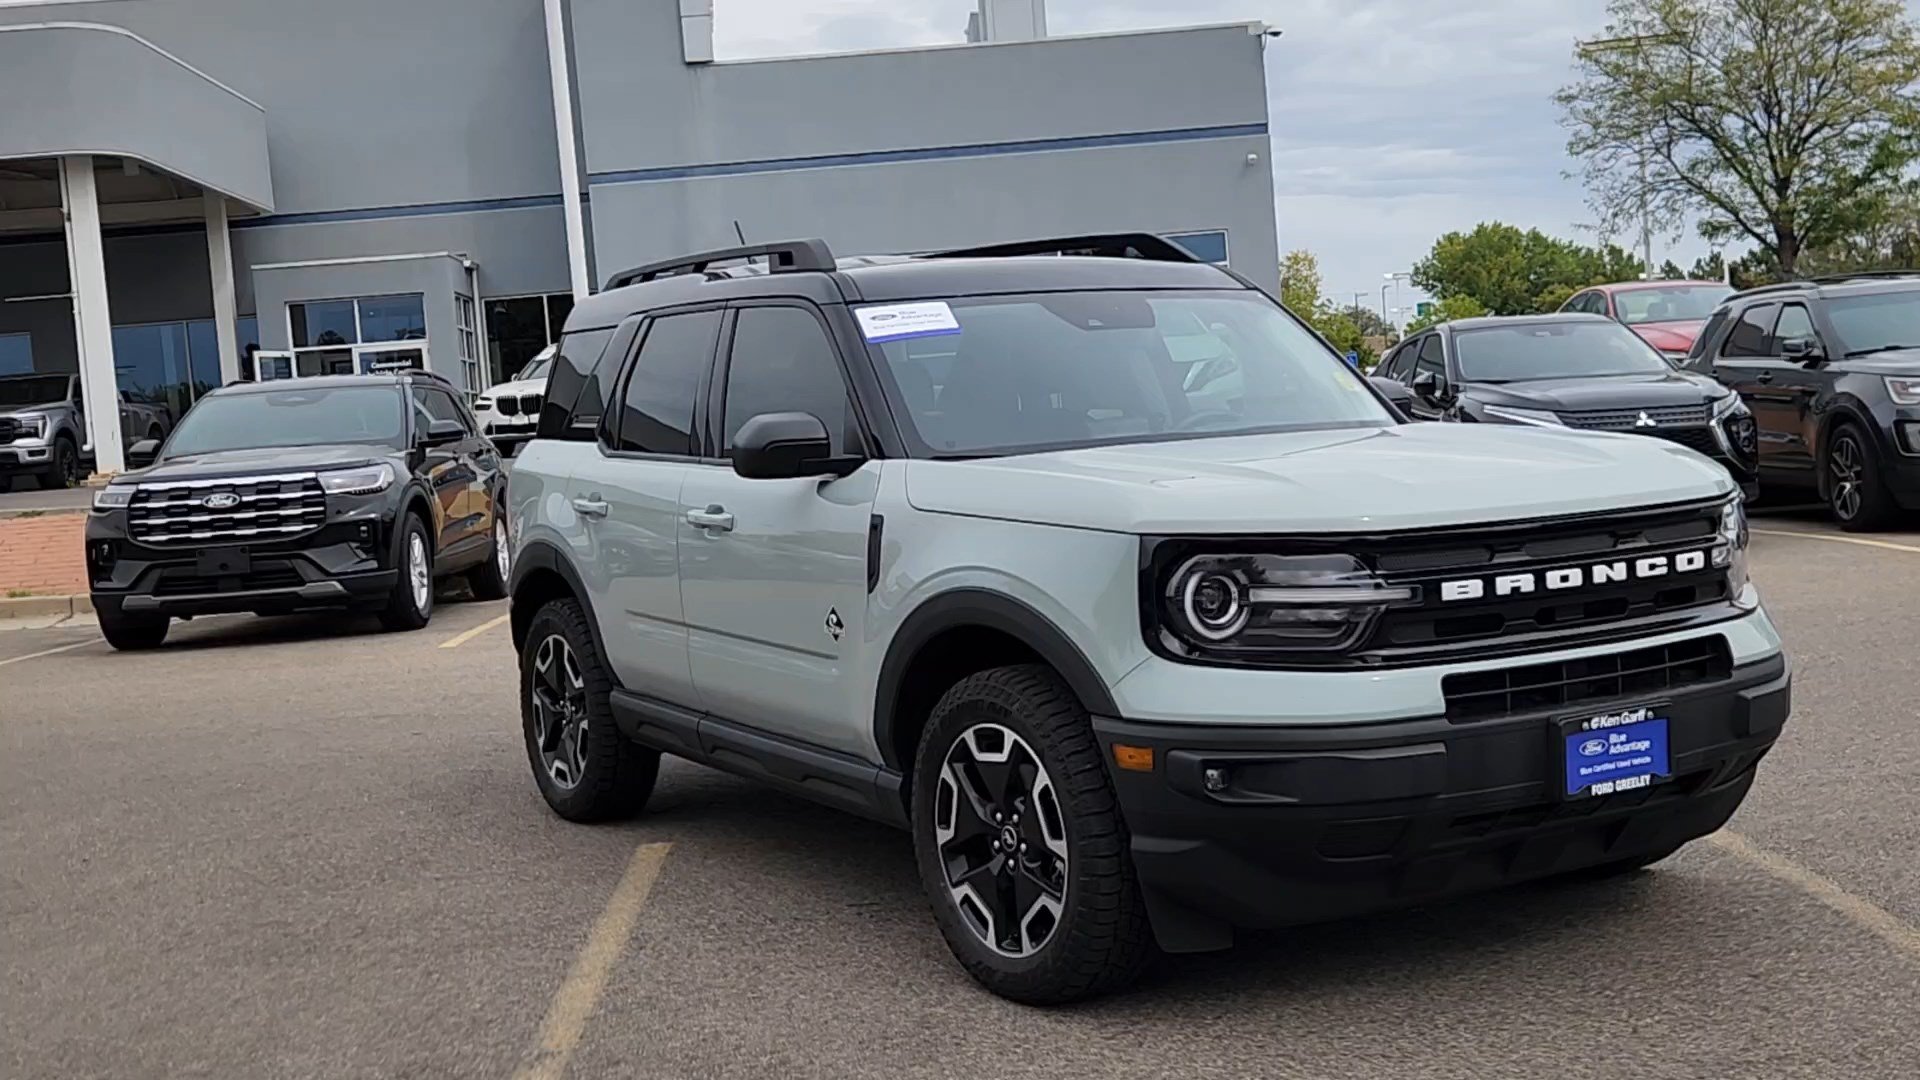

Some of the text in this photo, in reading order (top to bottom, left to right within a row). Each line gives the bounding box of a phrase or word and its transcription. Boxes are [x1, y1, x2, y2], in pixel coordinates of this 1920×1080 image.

[371, 358, 412, 369] Commercial
[1441, 550, 1705, 602] BRONCO
[1600, 708, 1647, 728] Ken Garff
[1609, 733, 1627, 744] Blue
[1609, 740, 1651, 755] Advantage
[1591, 774, 1651, 796] FORD GREELEY
